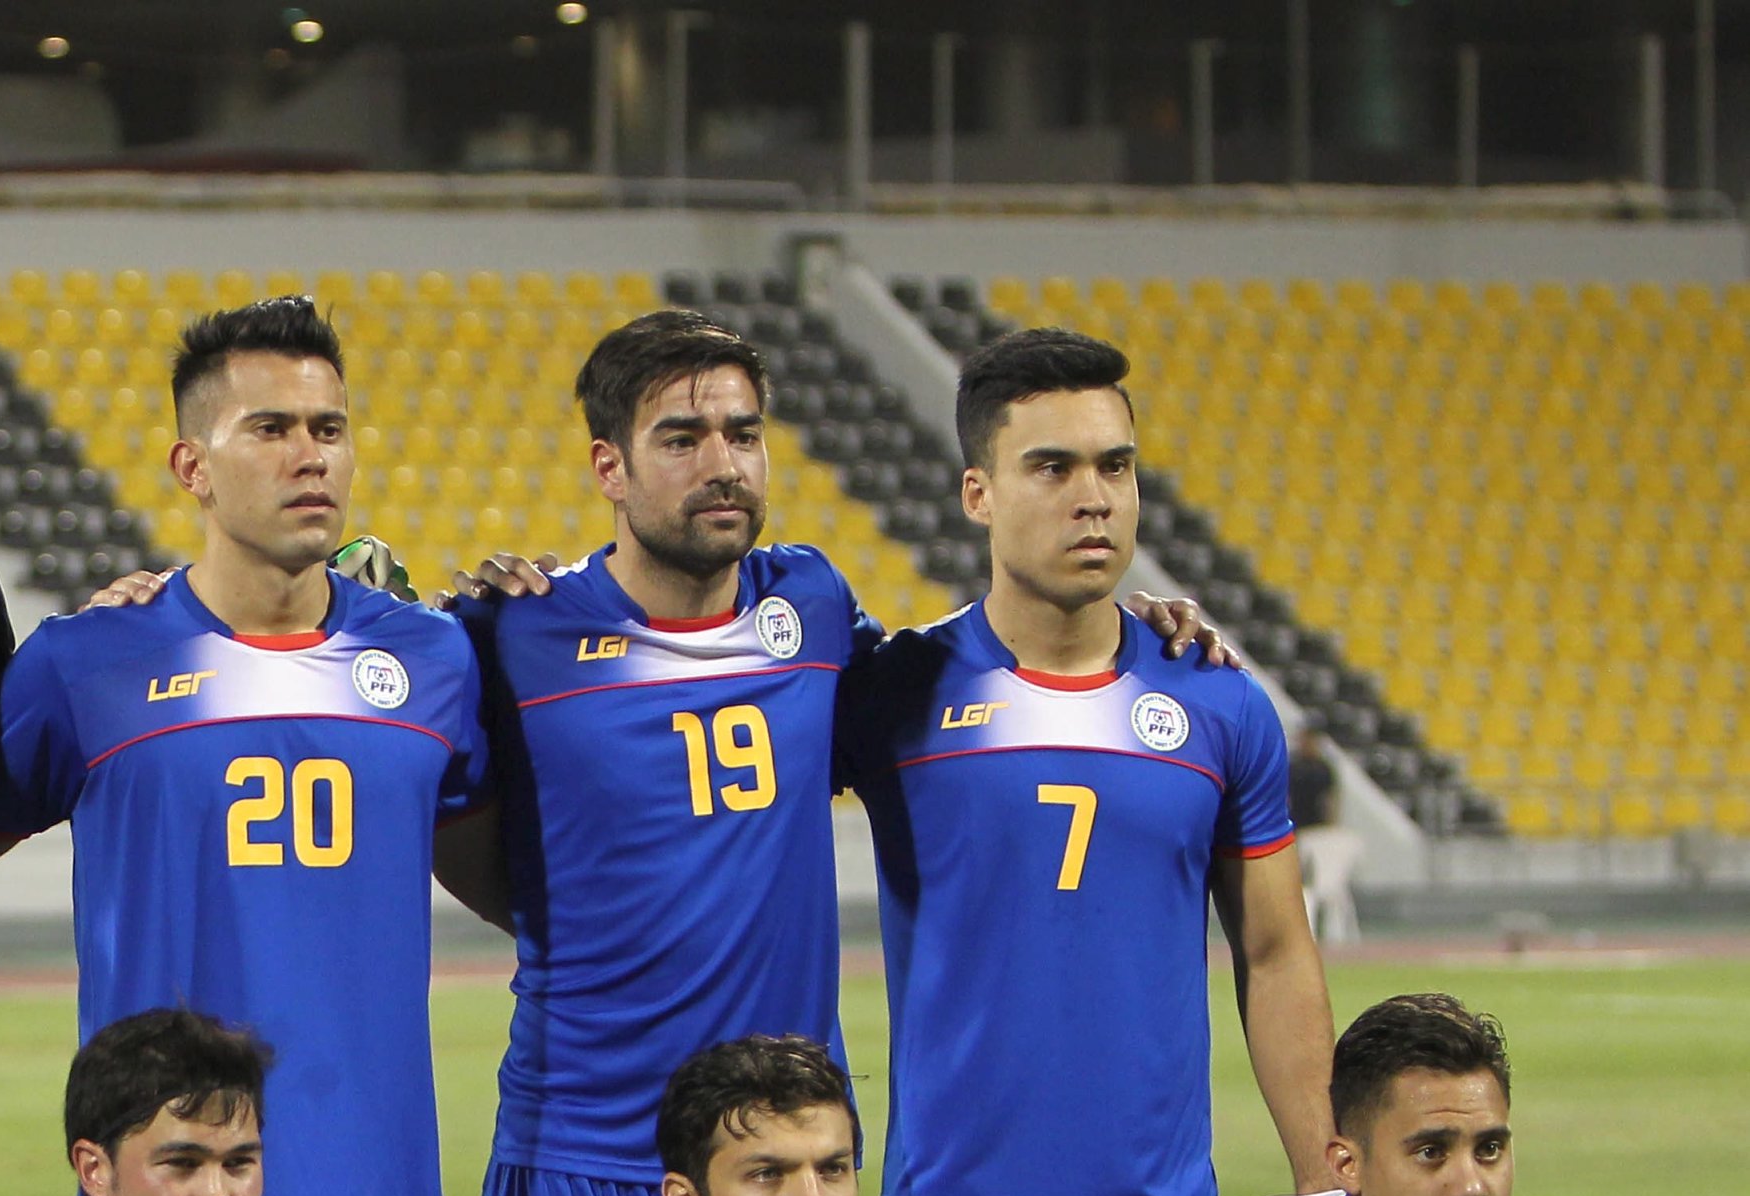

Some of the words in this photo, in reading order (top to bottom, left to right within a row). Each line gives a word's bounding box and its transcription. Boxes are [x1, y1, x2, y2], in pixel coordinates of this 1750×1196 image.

[773, 630, 793, 644] PFF
[370, 681, 398, 694] PFF
[1149, 723, 1177, 737] PFF
[673, 705, 776, 816] 19
[226, 757, 354, 868] 20
[1038, 785, 1097, 890] 7
